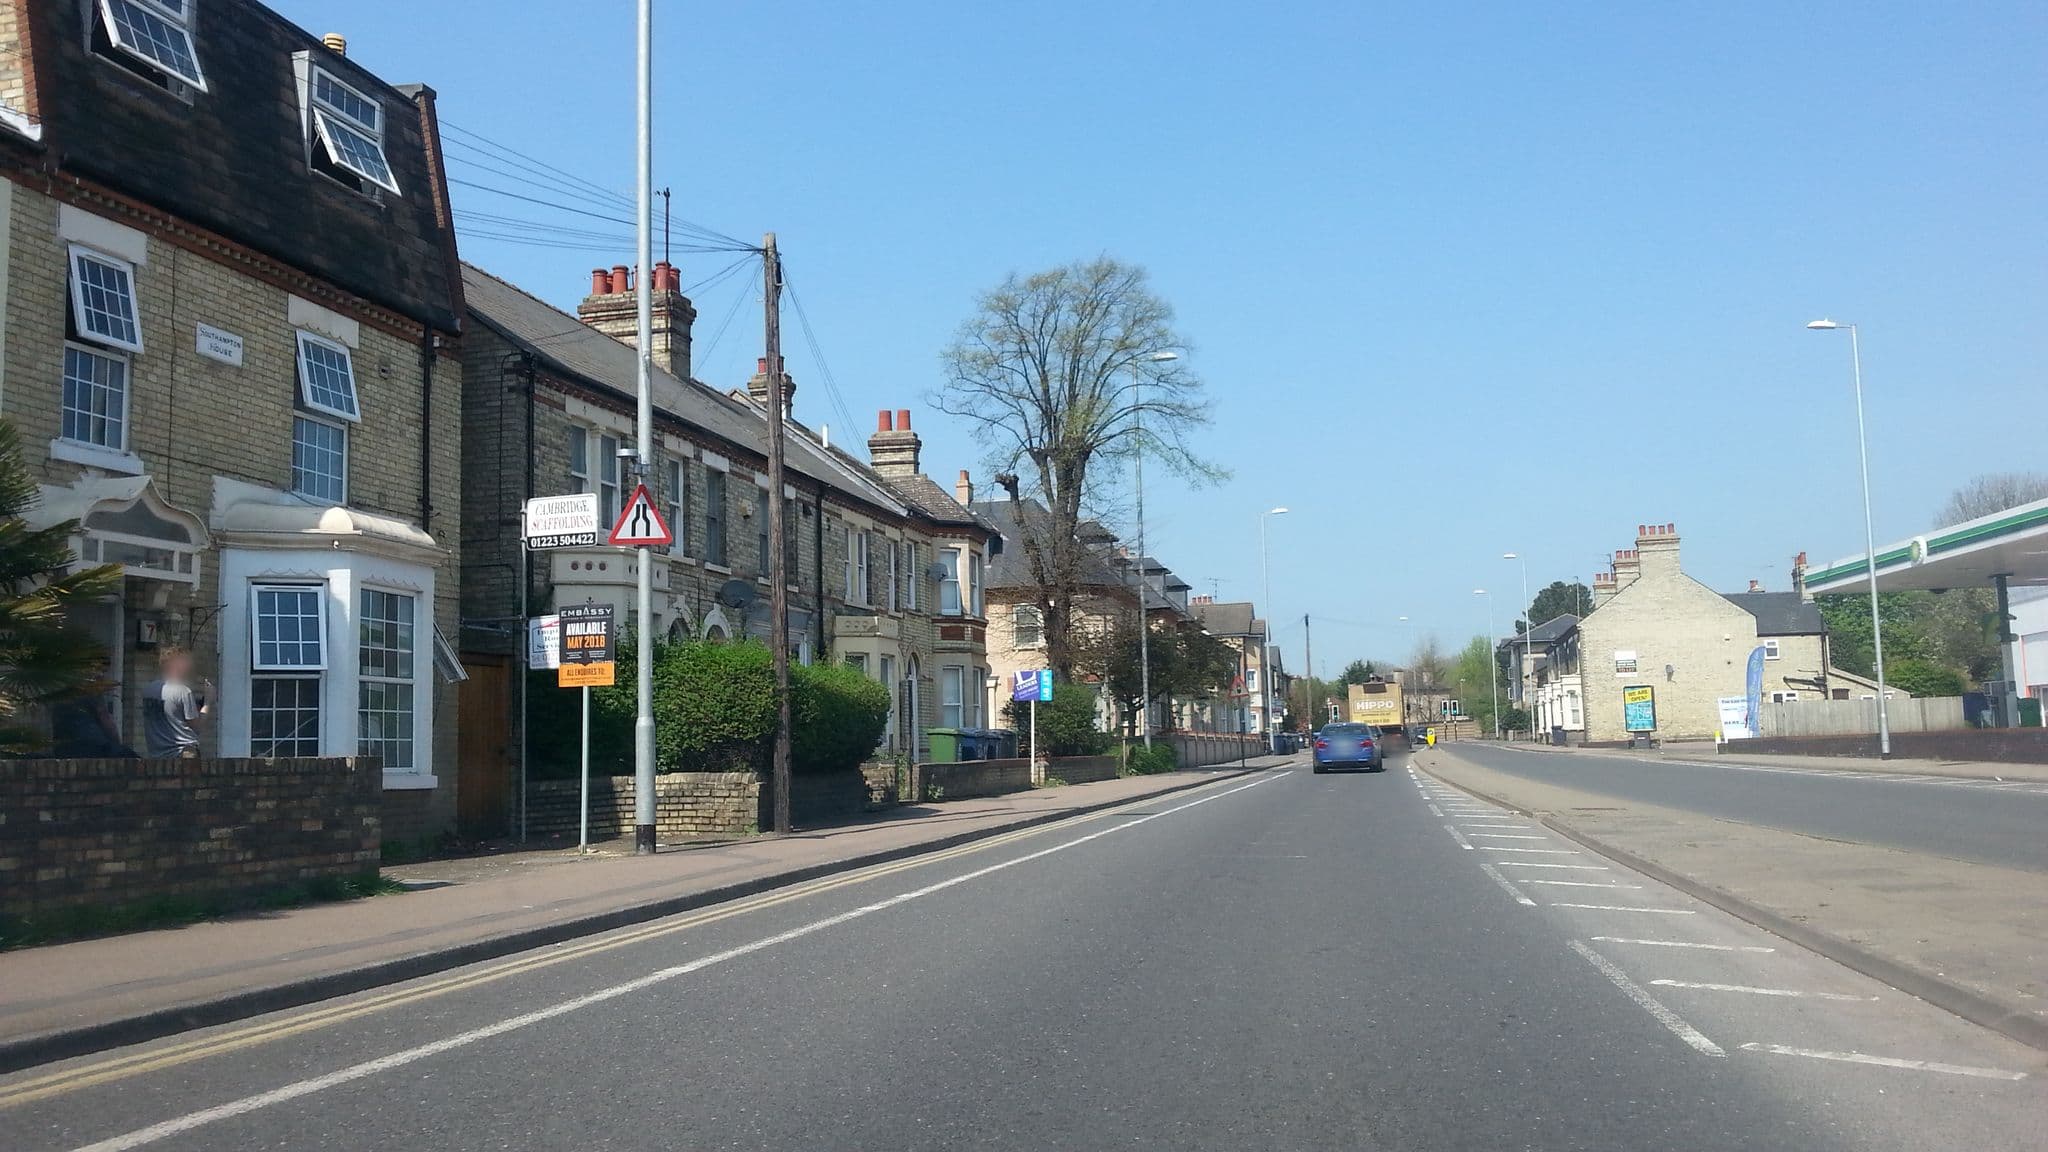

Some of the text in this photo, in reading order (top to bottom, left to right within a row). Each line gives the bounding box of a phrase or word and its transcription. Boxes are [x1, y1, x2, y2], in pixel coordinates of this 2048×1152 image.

[209, 343, 233, 357] HOUSE
[535, 500, 590, 515] CAMBRIDGE
[531, 515, 593, 531] SCAFFOLDING
[531, 533, 594, 548] 01223 504422
[561, 607, 612, 617] EMBASSY
[146, 624, 156, 640] 7
[566, 621, 607, 636] AVAILABLE
[567, 635, 606, 650] MAY 2018
[1356, 700, 1394, 710] HIPPO
